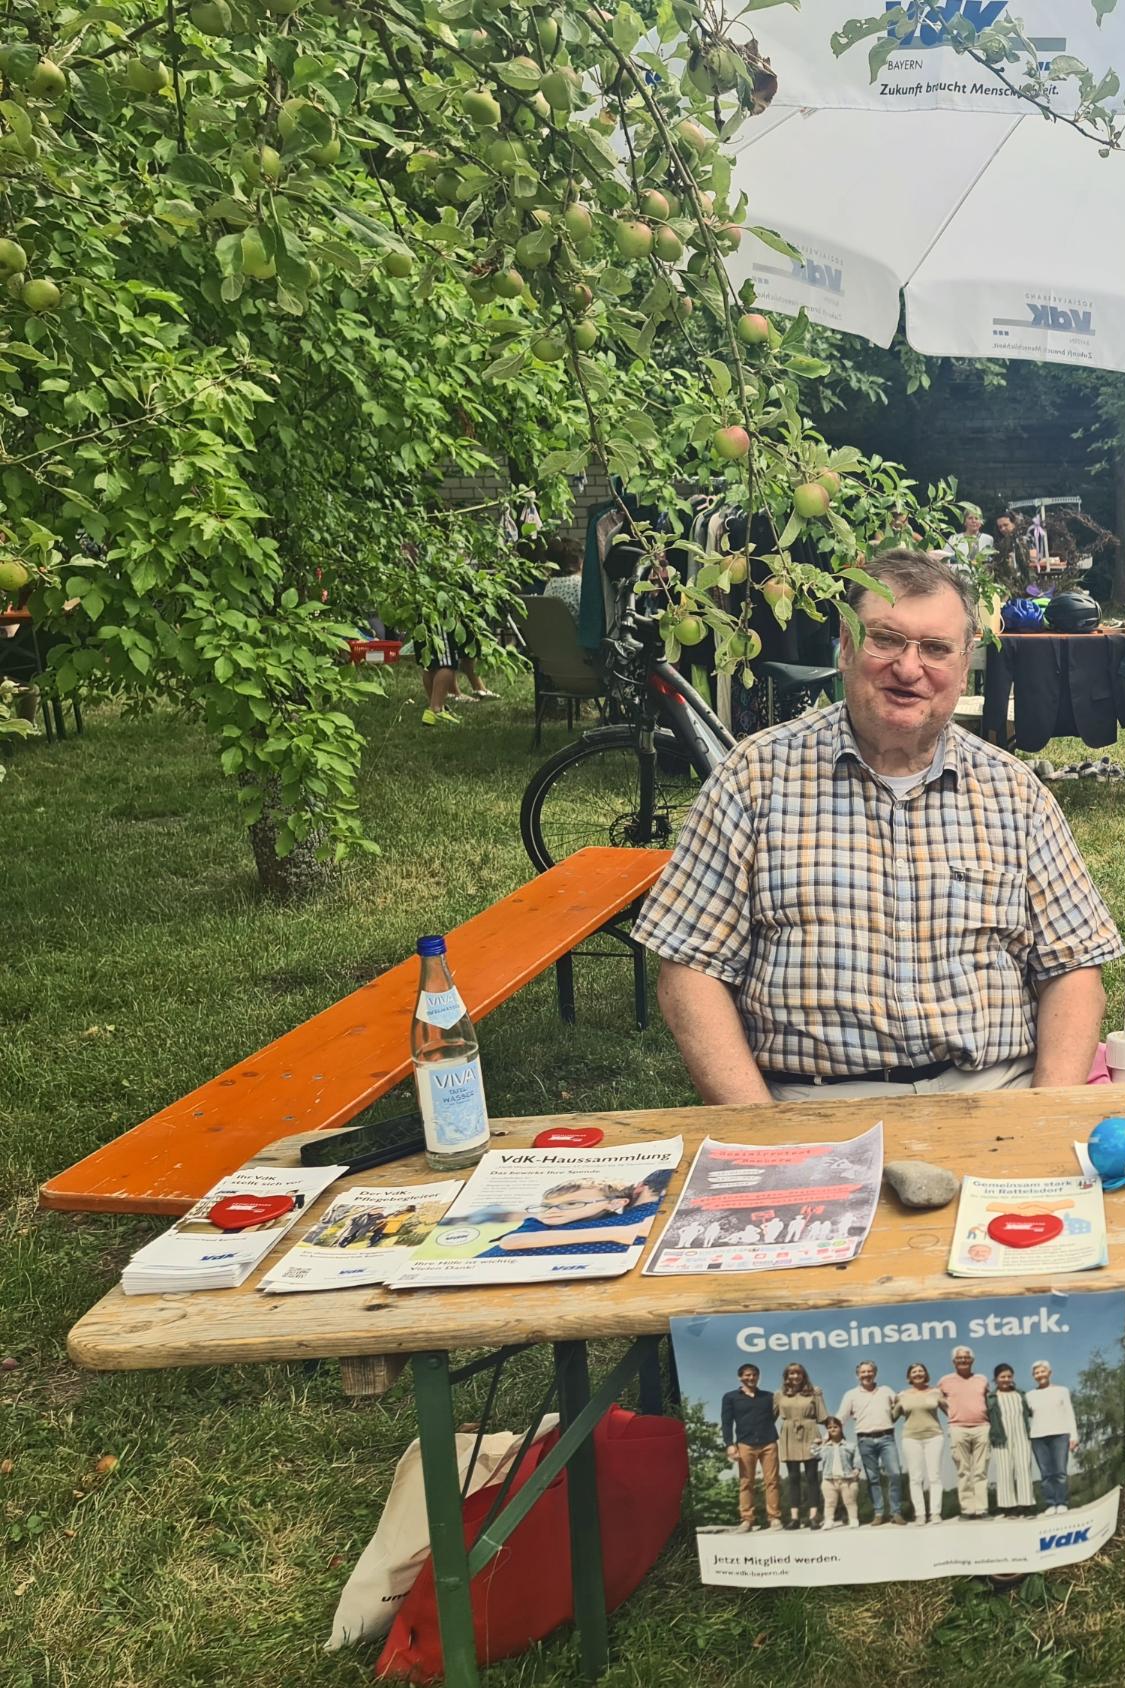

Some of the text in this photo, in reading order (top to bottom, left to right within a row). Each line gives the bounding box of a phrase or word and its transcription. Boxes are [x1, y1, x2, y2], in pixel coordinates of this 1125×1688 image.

[888, 60, 923, 71] BAYERN
[880, 83, 922, 96] Zukunft
[428, 994, 455, 1006] VIVA
[434, 1068, 476, 1089] VIVA
[501, 1152, 672, 1165] VdK-Haussammlung
[1044, 1180, 1072, 1188] stark
[201, 1252, 238, 1262] VdK
[736, 1307, 1070, 1352] Gemeinsam stark.
[1039, 1527, 1092, 1552] VdK
[713, 1554, 841, 1567] Jetzt Mitglied werden.
